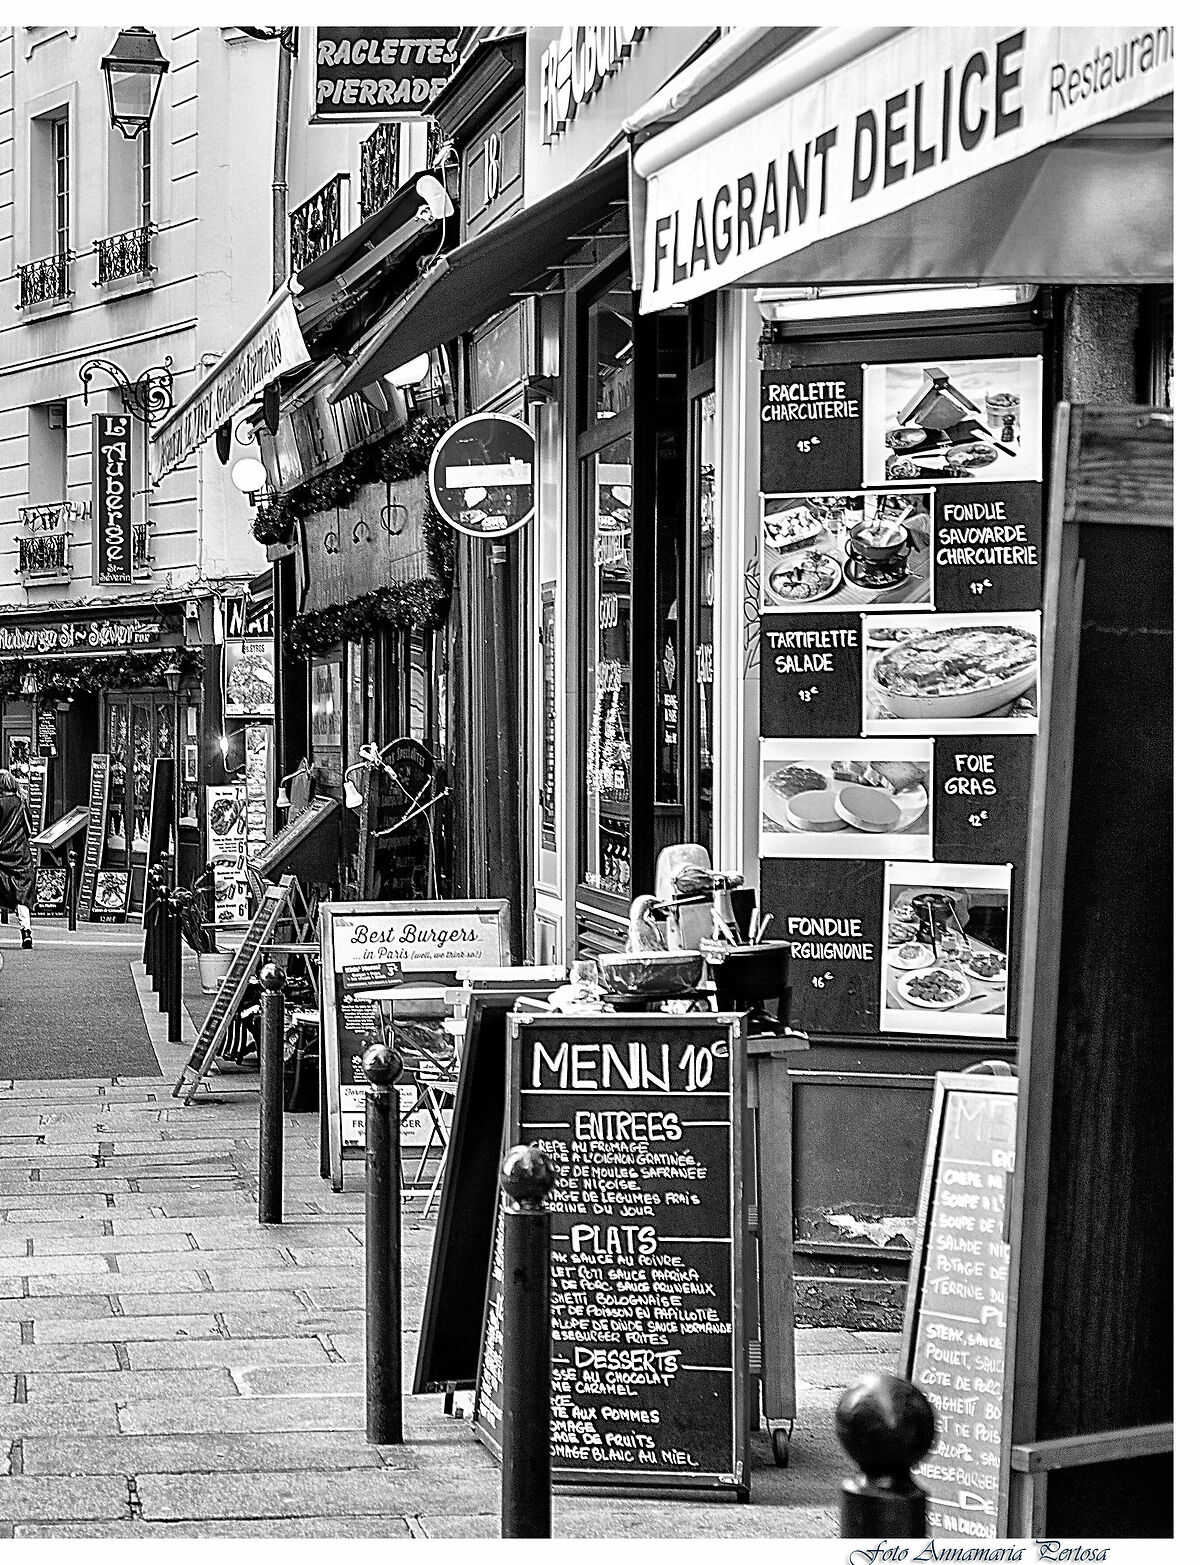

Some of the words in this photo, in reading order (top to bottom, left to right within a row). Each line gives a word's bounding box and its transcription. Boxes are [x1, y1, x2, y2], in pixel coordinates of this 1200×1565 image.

[318, 39, 458, 66] RACLETTES
[652, 125, 839, 292] FLAGRANT
[851, 29, 1027, 203] DELICE
[769, 381, 846, 401] RACLETTE
[762, 401, 860, 422] CHARCUTERIE
[944, 502, 1006, 521] FONDUE
[939, 525, 1028, 545] SAVOYARDE
[937, 546, 1039, 566] CHARCUTERIE
[767, 630, 857, 649] TARTIFLETTE
[776, 653, 834, 673] SALADE
[955, 754, 995, 773] FOIE
[945, 777, 997, 796] GRAS
[351, 925, 395, 944] Best
[788, 918, 863, 937] FONDUE
[378, 947, 409, 960] Paris
[532, 1041, 670, 1092] MENU
[678, 1041, 729, 1092] 10€
[576, 1111, 682, 1141] ENTREES
[572, 1141, 587, 1153] AU
[590, 1141, 650, 1154] FROMAGE
[572, 1153, 581, 1163] A
[583, 1153, 636, 1165] L'OIGNON
[573, 1165, 590, 1178] DE
[582, 1191, 599, 1203] DE
[593, 1204, 613, 1216] DU
[620, 1205, 656, 1217] JOUR
[939, 1213, 976, 1231] SOUPE
[980, 1219, 996, 1233] DE
[571, 1224, 657, 1255] PLATS
[937, 1235, 983, 1255] SALADE
[571, 1253, 614, 1265] SAUCE
[617, 1254, 634, 1266] AU
[937, 1255, 985, 1276] POTAGE
[990, 1267, 1008, 1280] DE
[608, 1269, 647, 1281] SAUCE
[561, 1279, 578, 1290] DE
[617, 1282, 650, 1293] SAUCE
[653, 1282, 716, 1297] PRUNEAUX
[930, 1277, 985, 1300] TERRINE
[568, 1305, 584, 1316] DE
[635, 1307, 650, 1319] EN
[592, 1319, 609, 1331] DE
[610, 1319, 644, 1332] DINDE
[647, 1321, 678, 1333] SAUCE
[680, 1323, 732, 1335] NORMANDE
[625, 1332, 669, 1345] FRITES
[574, 1346, 682, 1373] DESSERTS
[582, 1369, 600, 1383] AU
[605, 1371, 675, 1387] CHOCOLAT
[956, 1376, 971, 1392] DE
[574, 1382, 638, 1396] CARAMEL
[572, 1406, 598, 1420] AUX
[601, 1406, 660, 1424] POMMES
[582, 1434, 602, 1445] DE
[591, 1447, 634, 1462] BLANC
[638, 1450, 658, 1464] AU
